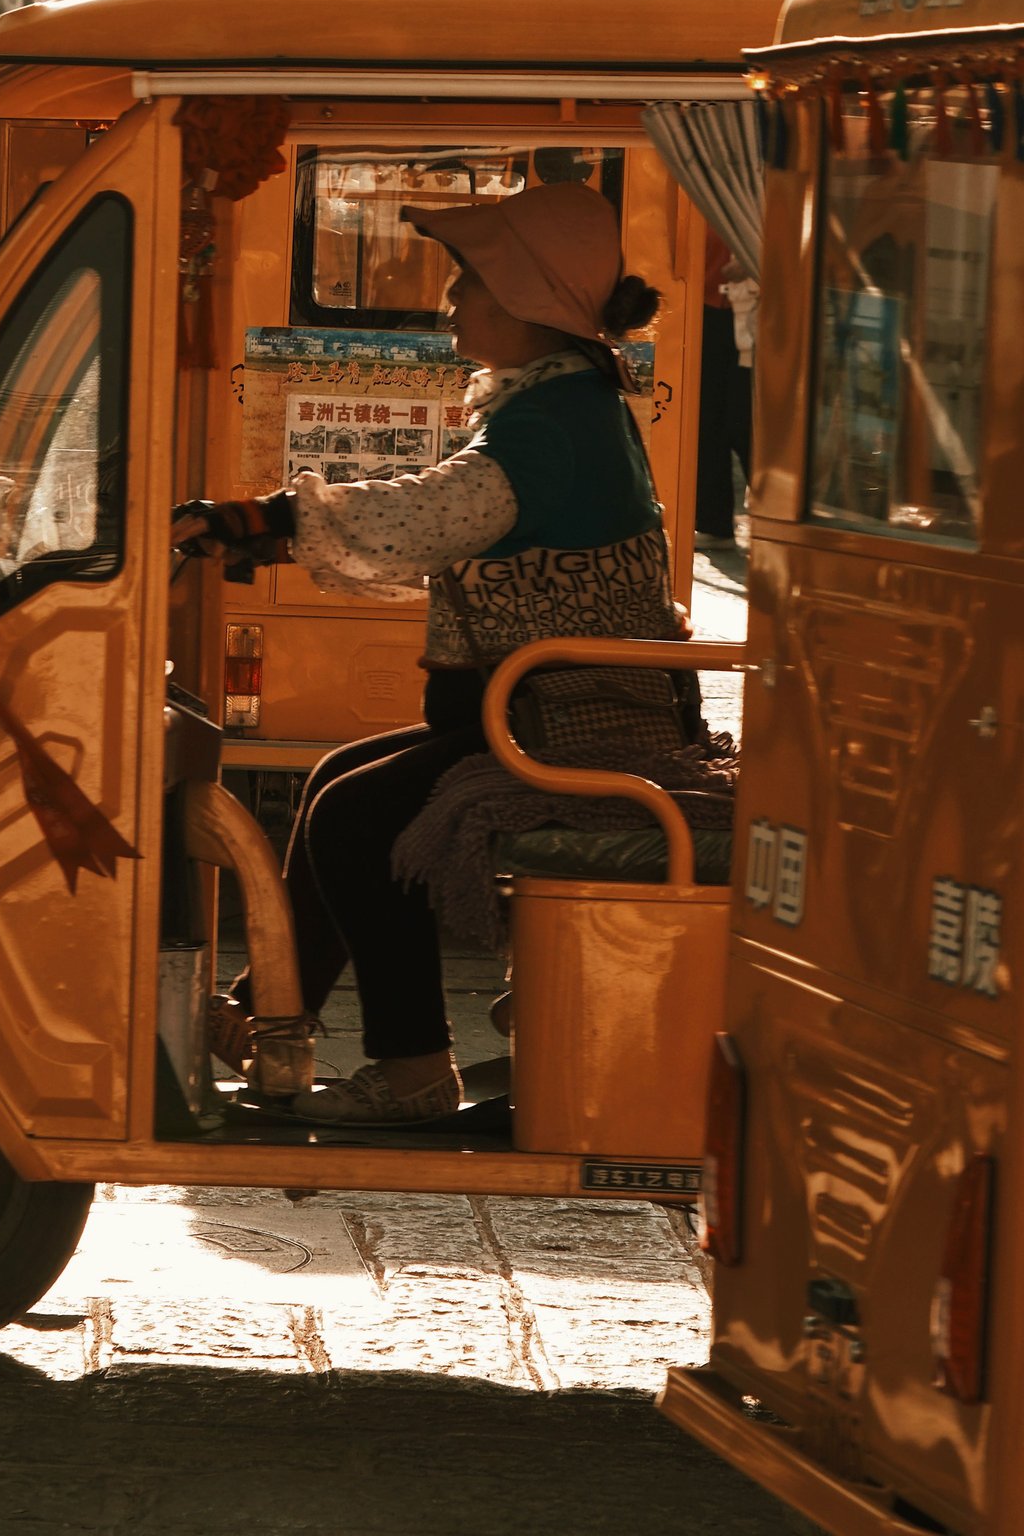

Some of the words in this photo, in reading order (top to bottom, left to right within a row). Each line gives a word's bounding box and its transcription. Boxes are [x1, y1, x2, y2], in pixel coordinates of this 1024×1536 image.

[298, 401, 428, 426] 喜洲古镇绕一圈
